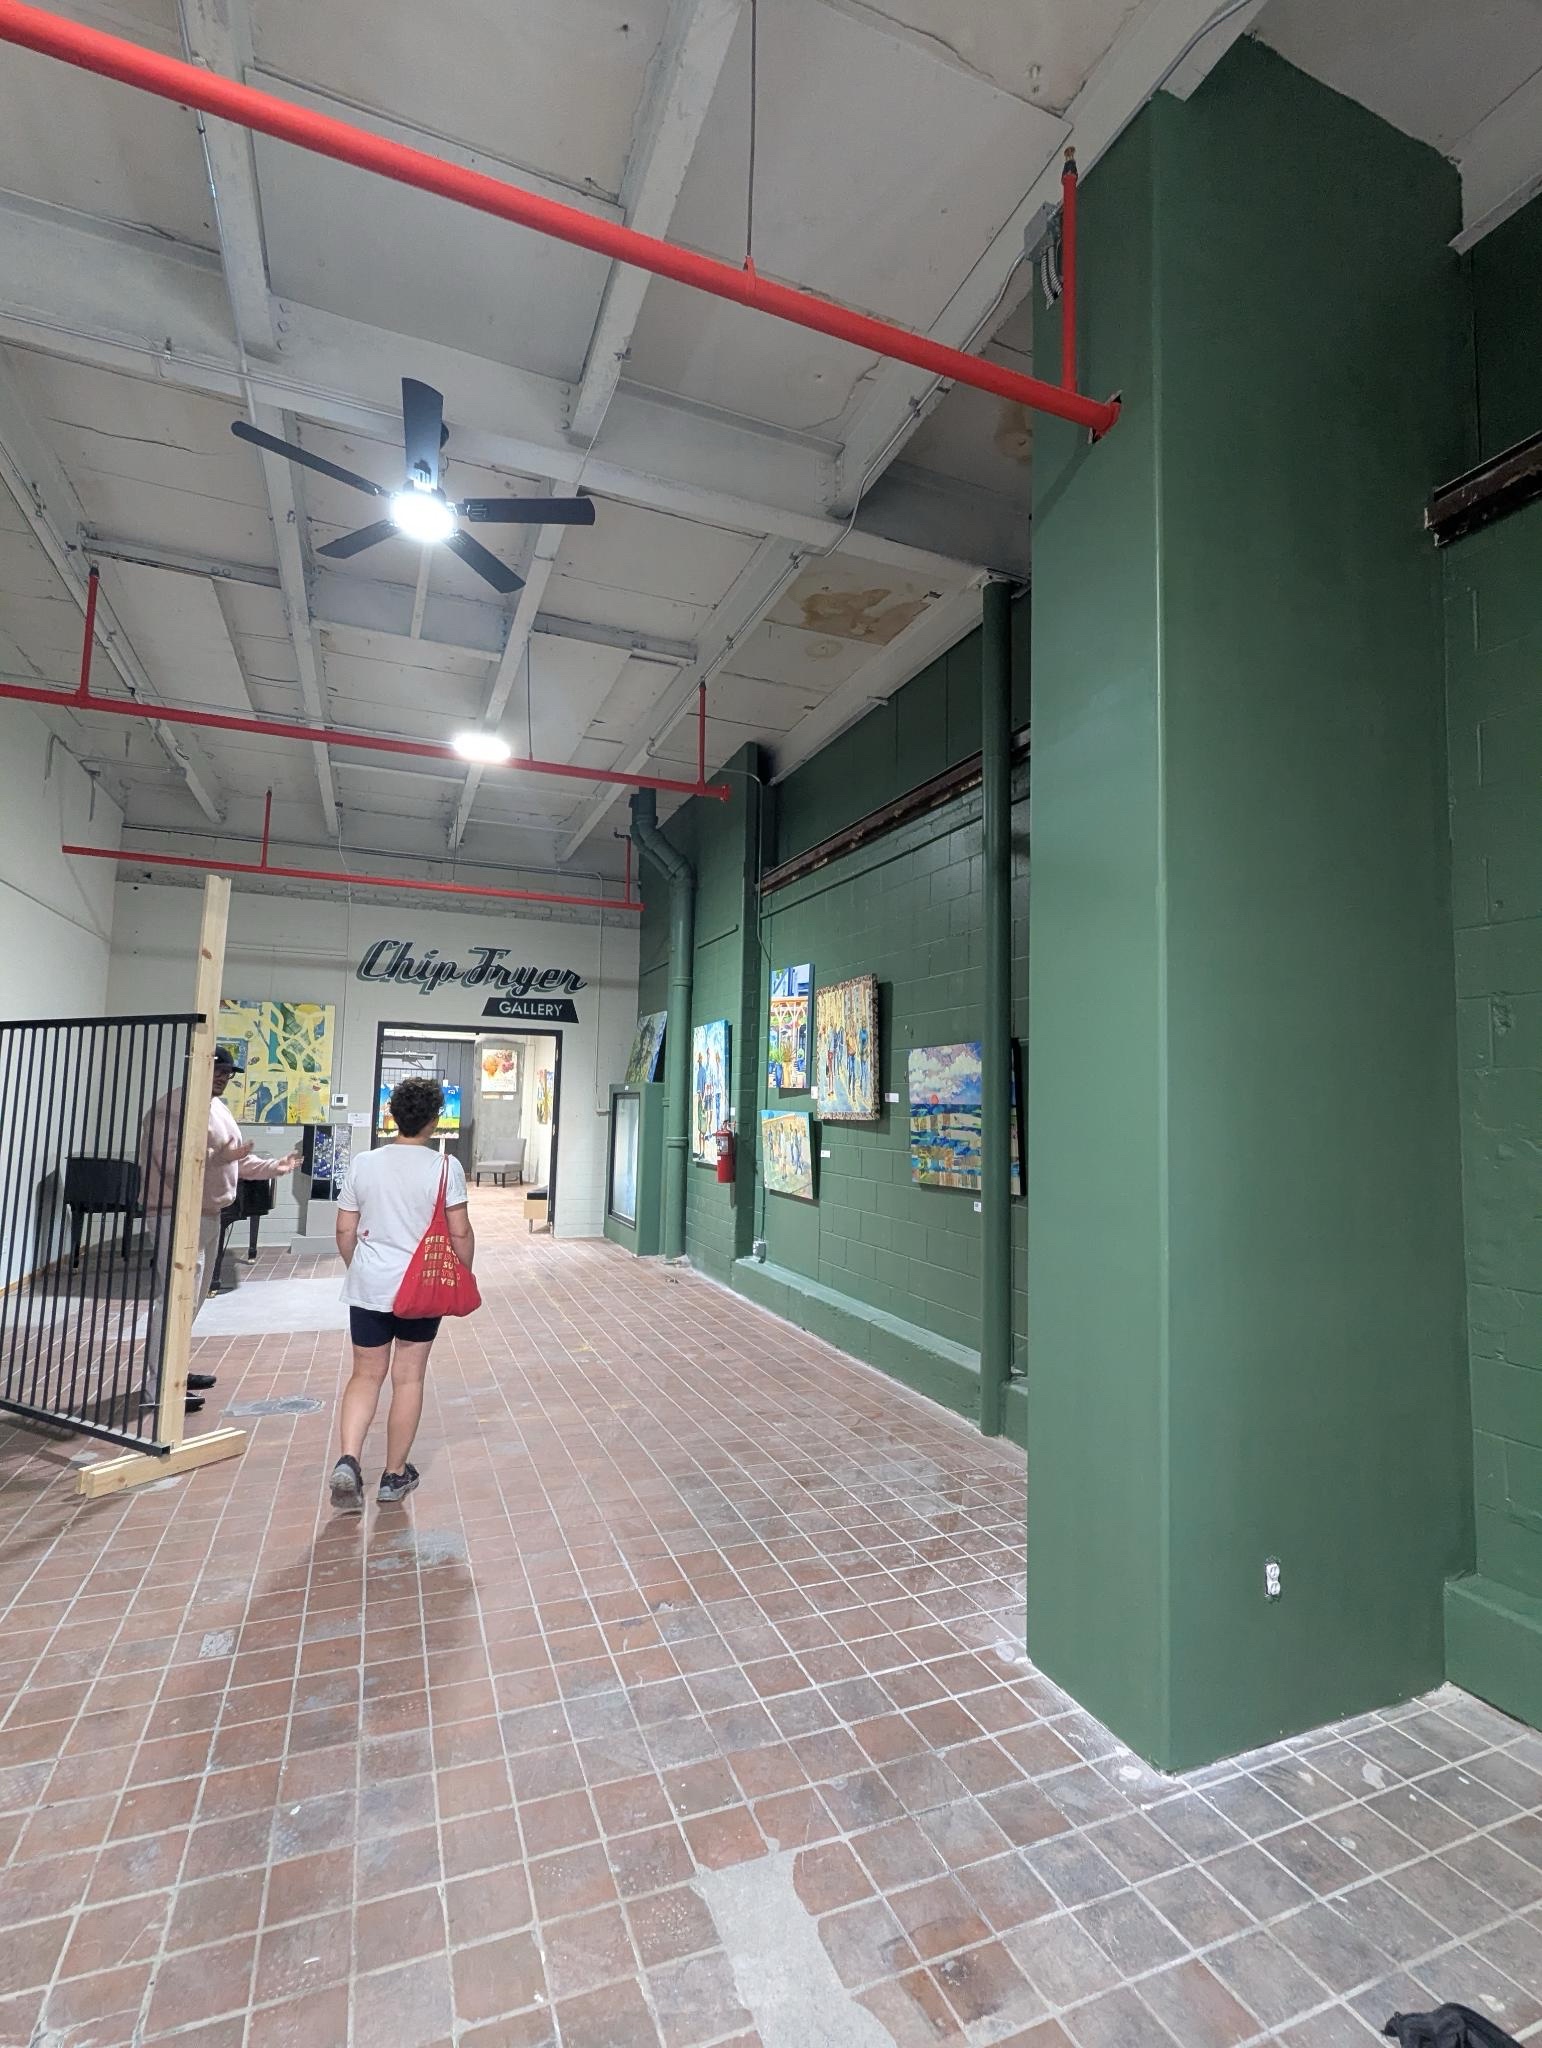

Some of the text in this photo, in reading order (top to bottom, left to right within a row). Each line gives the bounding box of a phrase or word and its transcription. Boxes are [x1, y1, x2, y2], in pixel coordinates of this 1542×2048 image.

[356, 939, 588, 998] Chip Fryer
[498, 1001, 563, 1017] GALLERY
